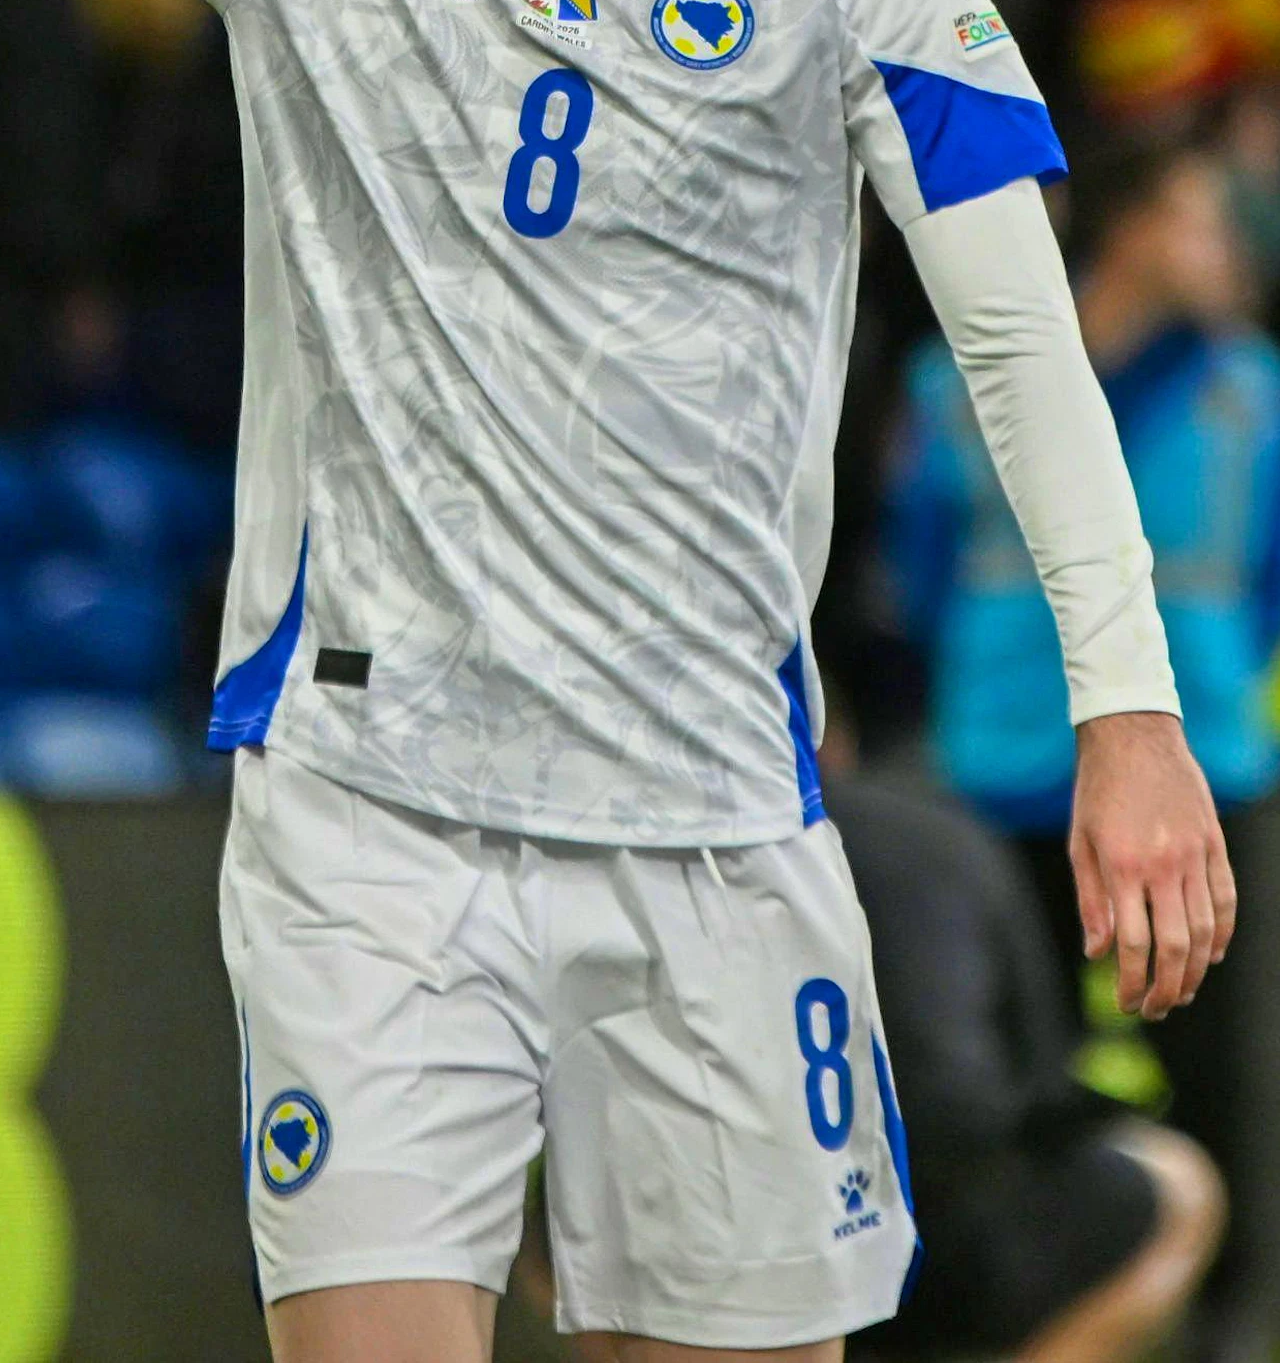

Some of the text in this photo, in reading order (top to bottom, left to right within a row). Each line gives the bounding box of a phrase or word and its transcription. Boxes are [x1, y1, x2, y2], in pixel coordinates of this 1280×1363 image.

[953, 12, 977, 28] UEFA
[503, 68, 594, 239] 8
[795, 978, 854, 1152] 8
[833, 1209, 881, 1241] KELME
